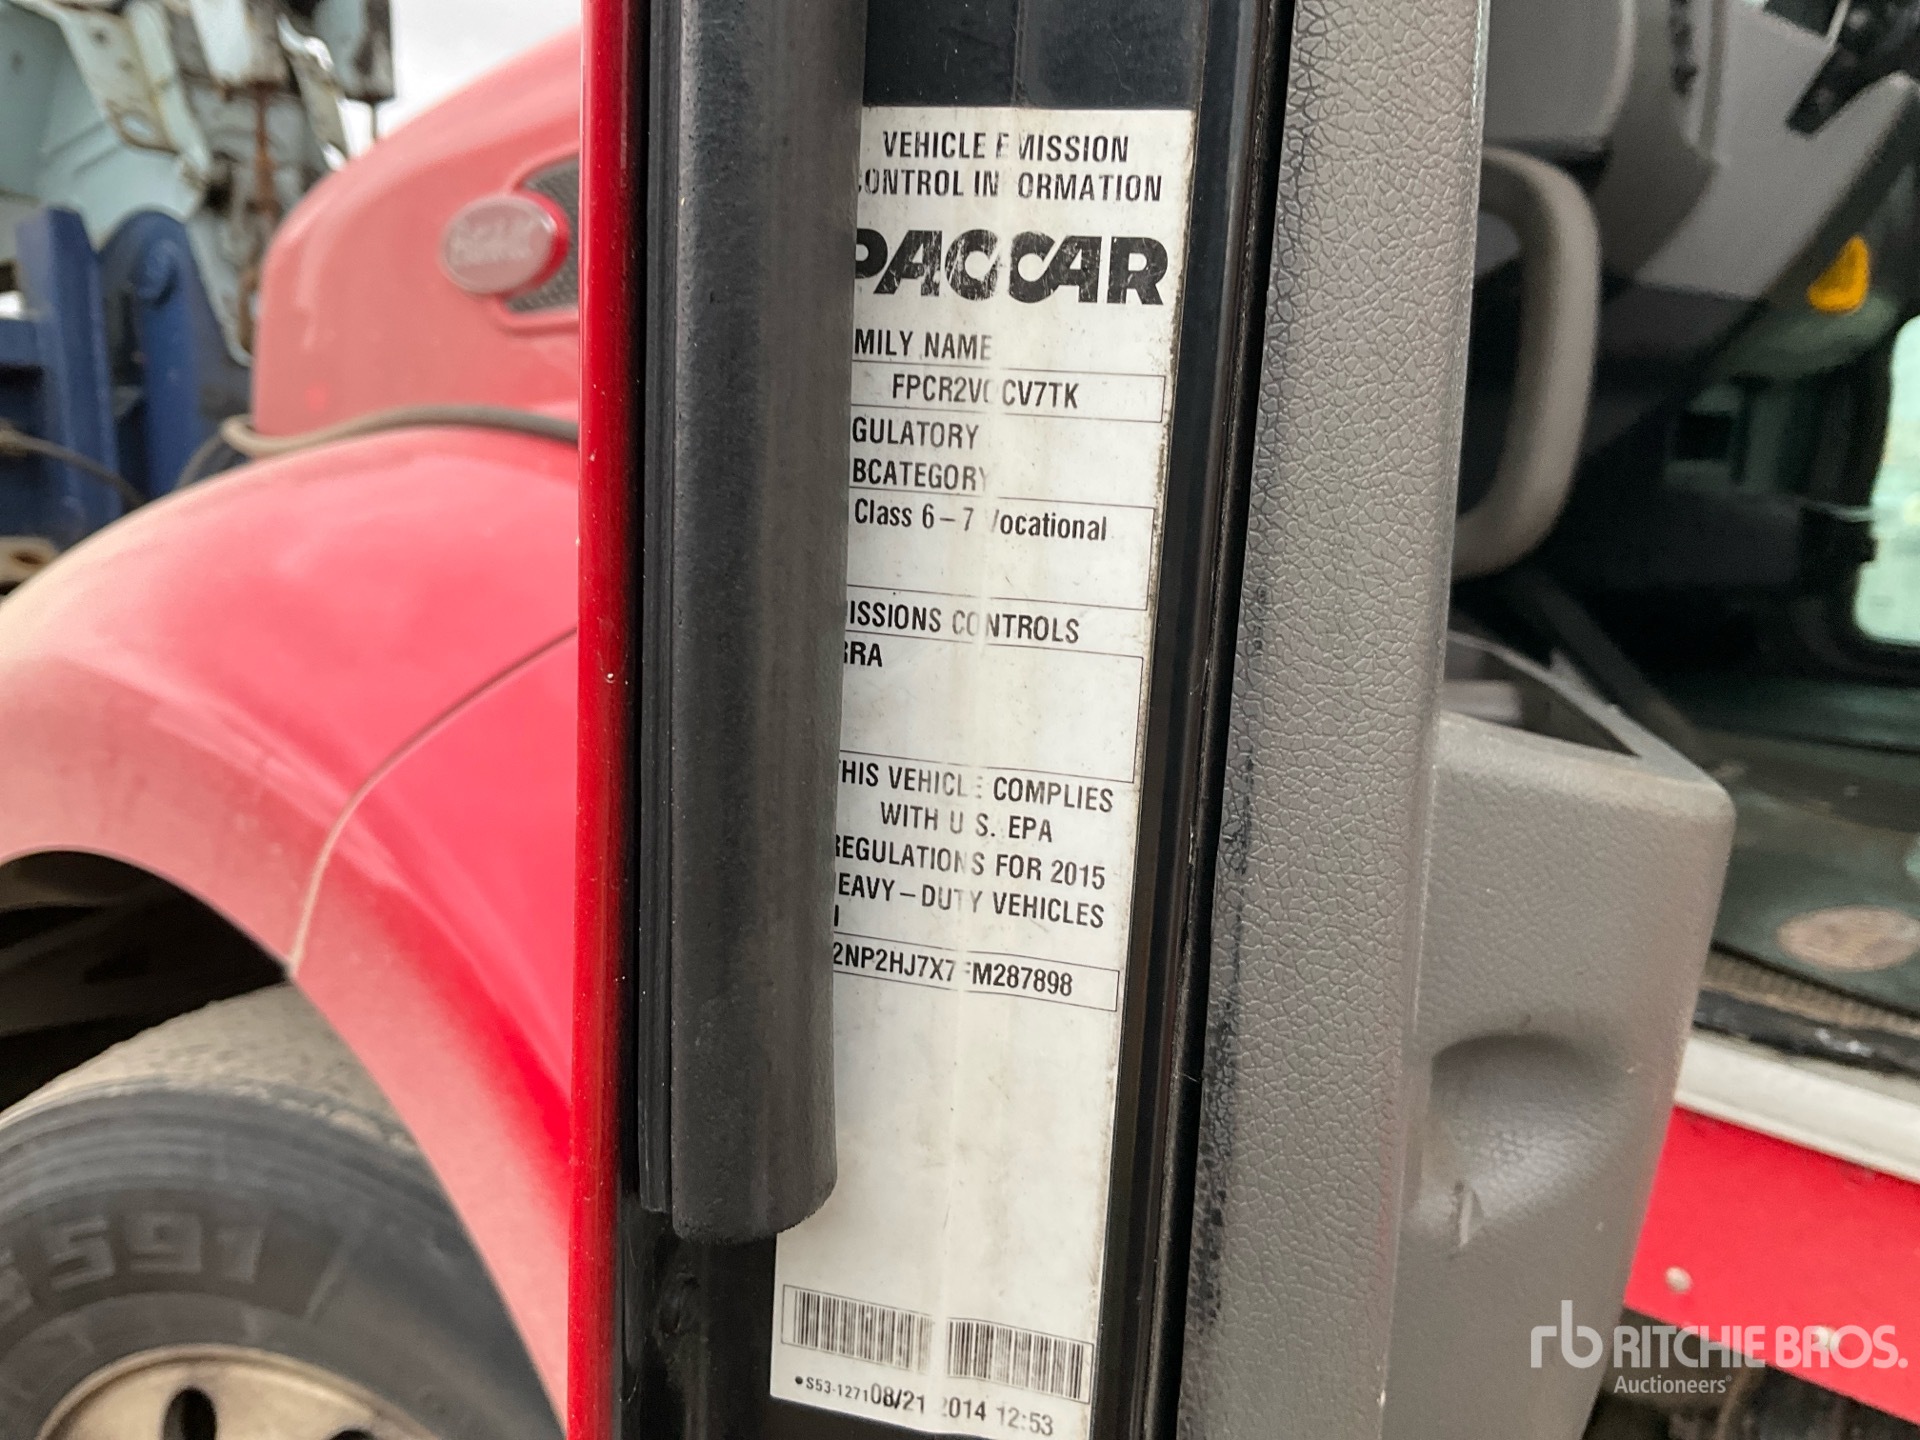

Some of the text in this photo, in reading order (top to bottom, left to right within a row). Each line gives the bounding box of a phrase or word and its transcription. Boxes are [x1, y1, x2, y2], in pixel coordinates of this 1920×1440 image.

[883, 130, 986, 159] VEHICLE
[973, 170, 1163, 203] INORMATION
[854, 328, 993, 361] MILY NAME
[851, 416, 980, 450] GULATORY
[852, 457, 990, 492] BCATEGORY
[854, 497, 913, 528] Class
[849, 600, 942, 633] ISSIONS
[838, 759, 880, 787] HIS
[993, 775, 1115, 813] COMPLIES
[880, 801, 939, 831] WITH
[1008, 814, 1054, 843] EPA
[995, 853, 1043, 881] FOR
[1050, 860, 1106, 891] 2015
[992, 890, 1106, 929] VEHICLES
